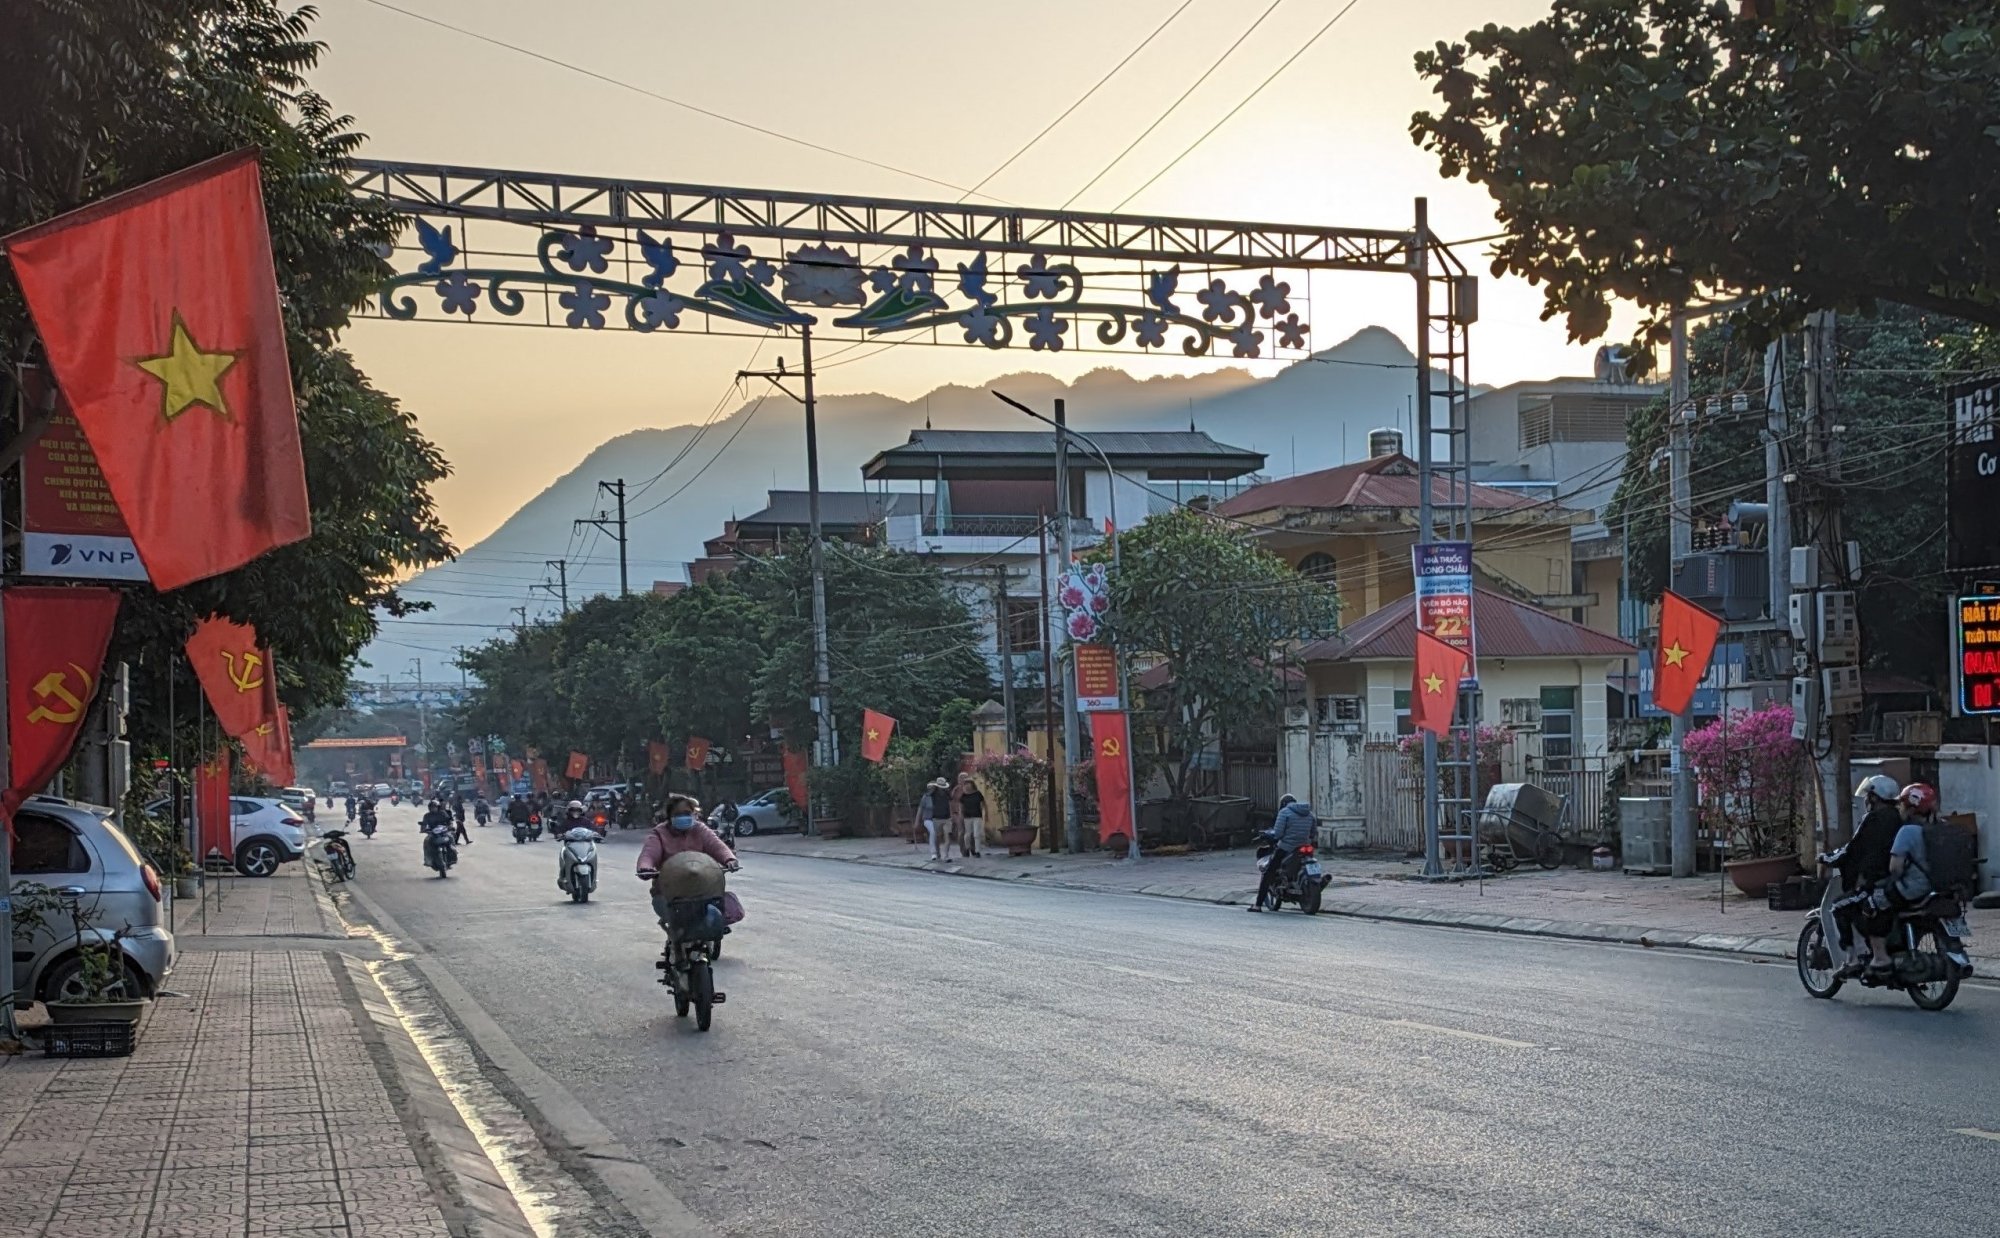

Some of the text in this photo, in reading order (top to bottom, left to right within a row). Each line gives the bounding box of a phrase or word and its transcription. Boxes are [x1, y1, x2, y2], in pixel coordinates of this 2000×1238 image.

[1954, 388, 1994, 445] Hải
[78, 549, 135, 564] VNP
[1424, 553, 1463, 564] NHÀ THUỐC
[1421, 564, 1469, 575] LONG CHÂU
[1963, 600, 1986, 623] HẢI
[1965, 627, 1986, 643] THỜI
[1964, 651, 2000, 674] NA
